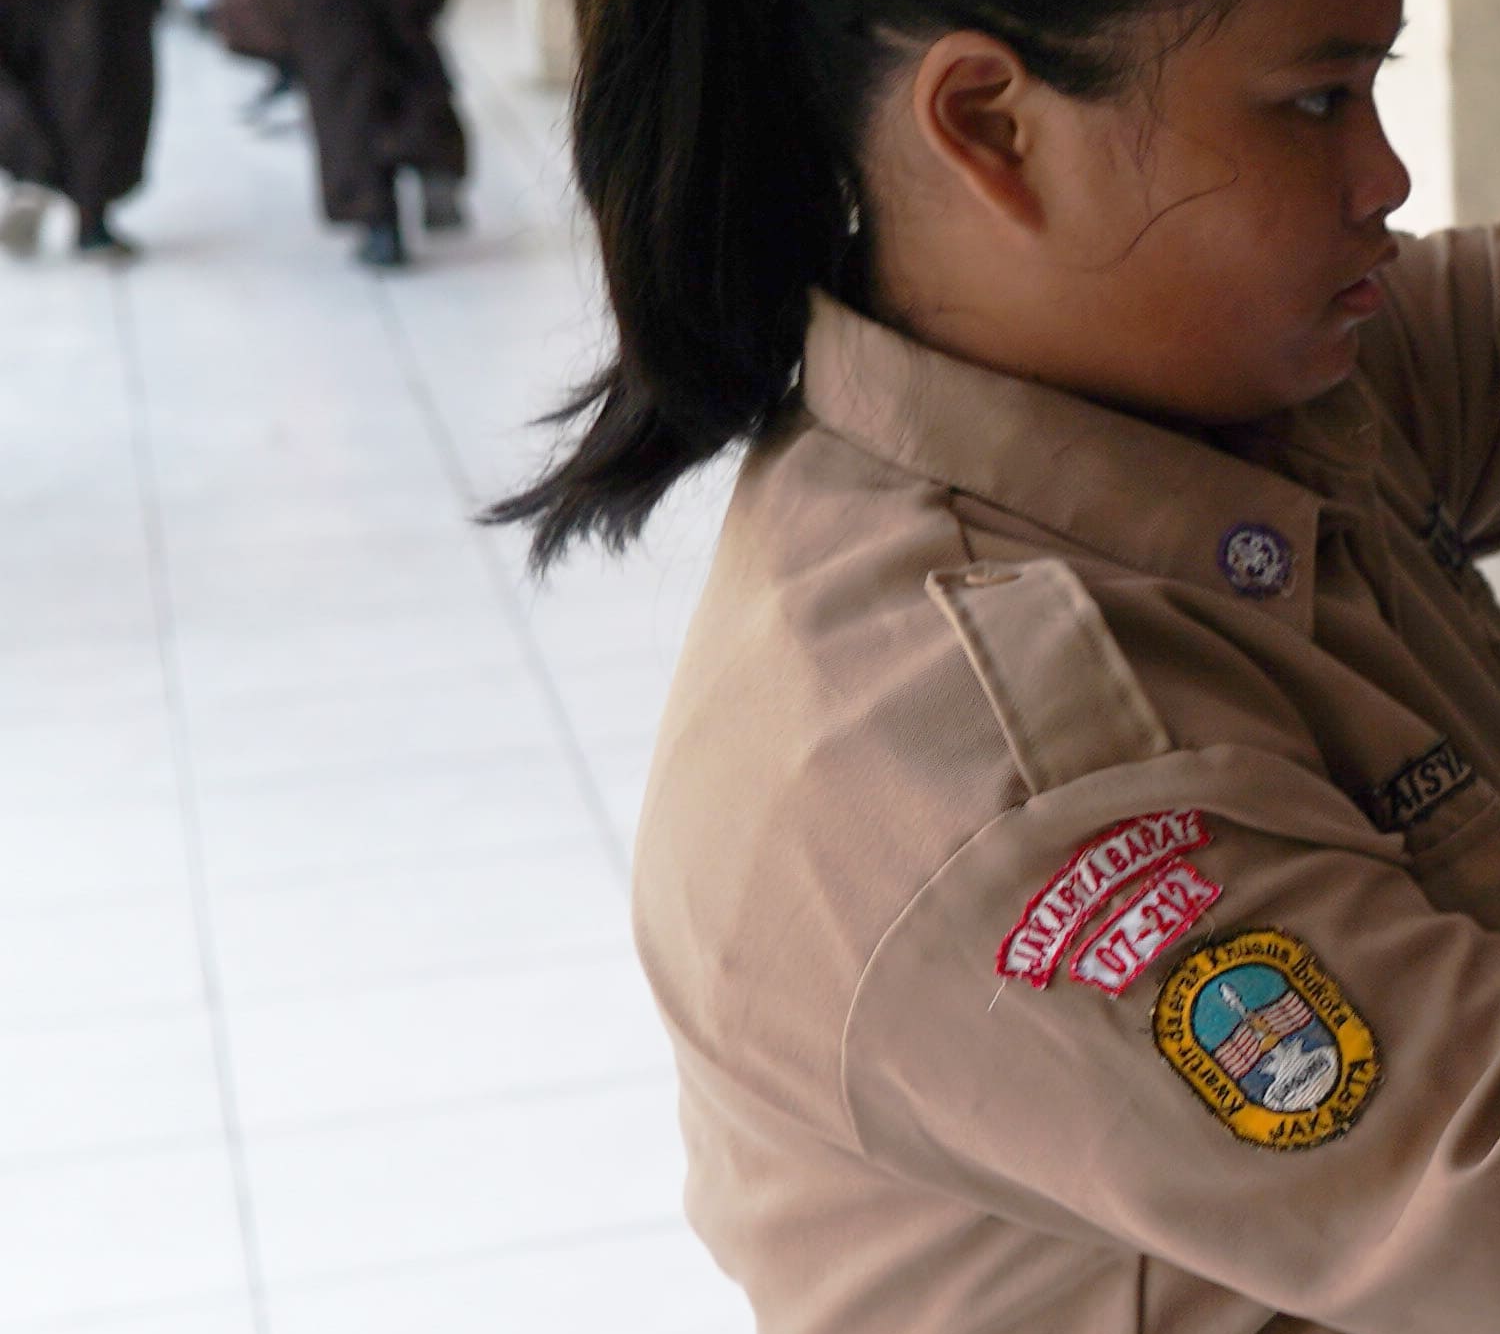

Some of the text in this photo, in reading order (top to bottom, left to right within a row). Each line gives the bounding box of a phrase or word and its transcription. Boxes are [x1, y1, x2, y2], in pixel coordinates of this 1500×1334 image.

[1014, 815, 1198, 971] JAKARTA BARAT
[1095, 881, 1203, 974] 07-212
[1178, 1046, 1245, 1117] Kwartir
